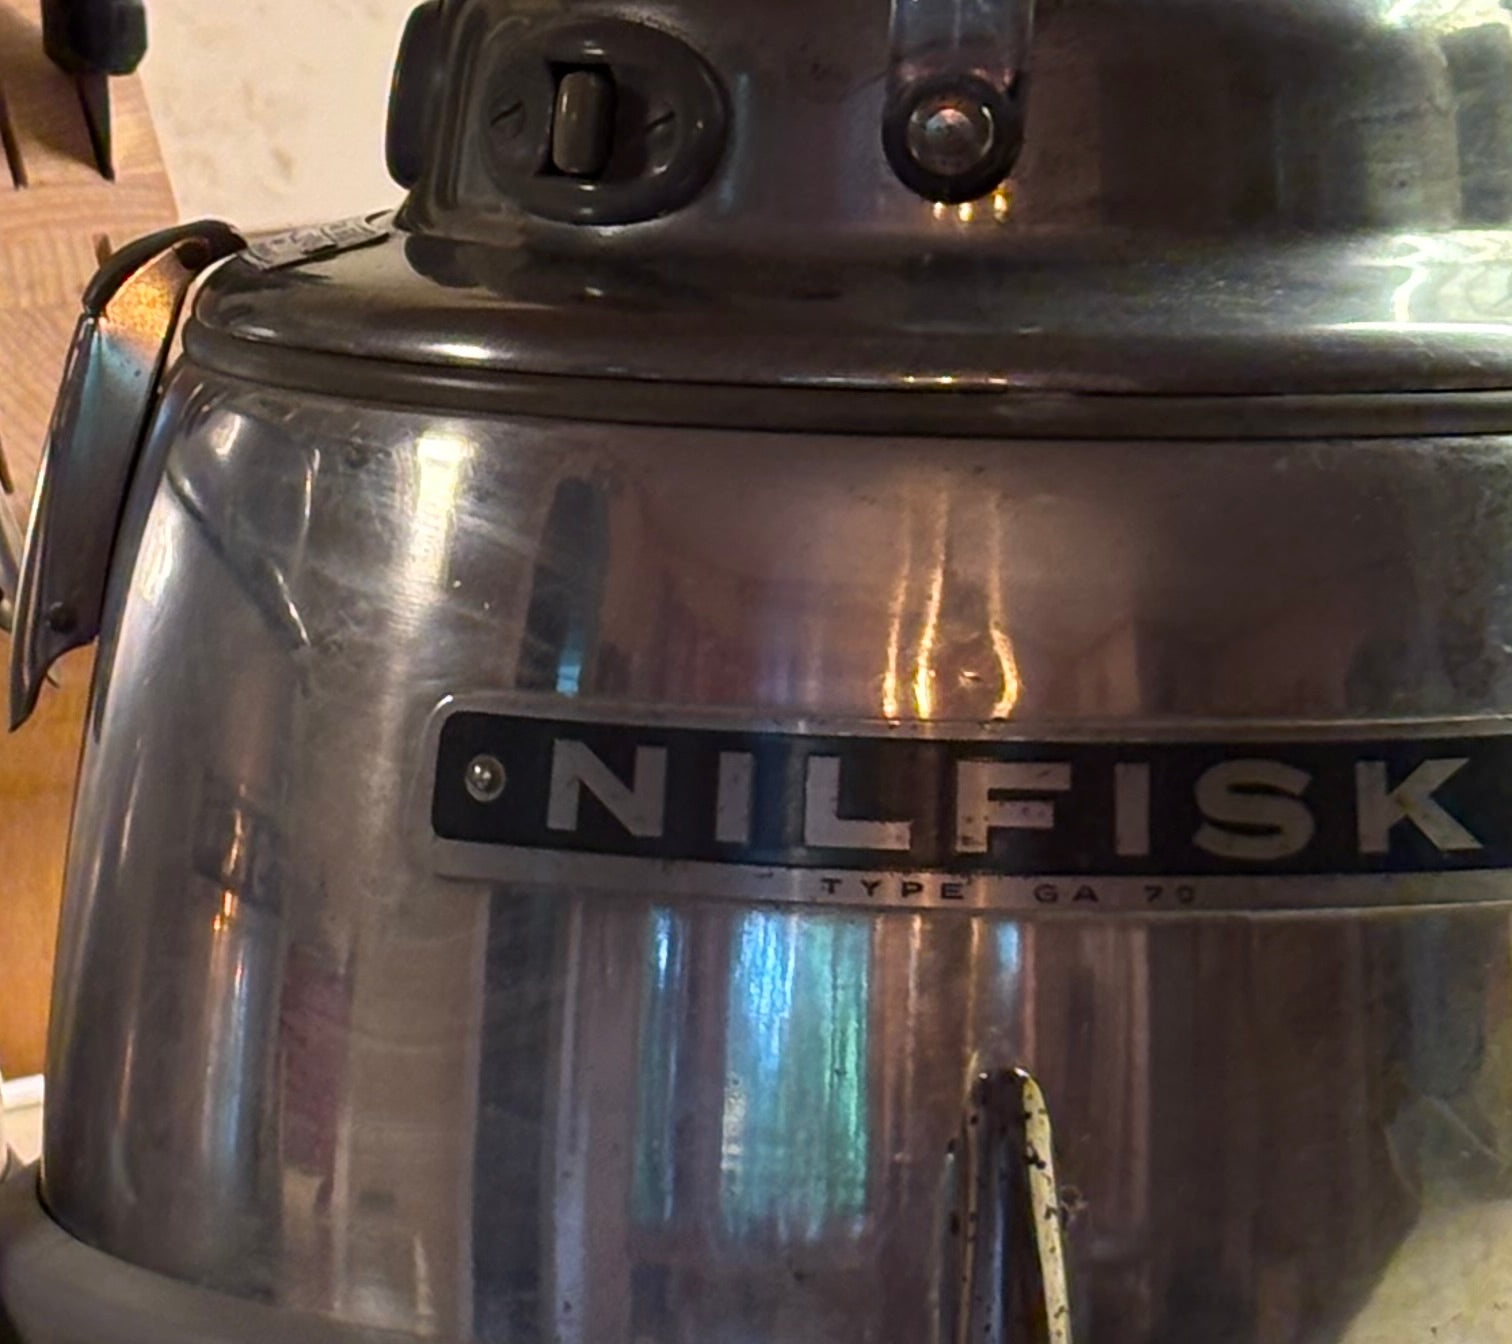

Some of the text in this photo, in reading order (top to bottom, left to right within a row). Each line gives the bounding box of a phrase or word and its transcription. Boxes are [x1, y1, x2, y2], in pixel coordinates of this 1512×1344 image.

[547, 738, 1483, 860] NILFISK
[819, 877, 1196, 904] TYPE GA 70
